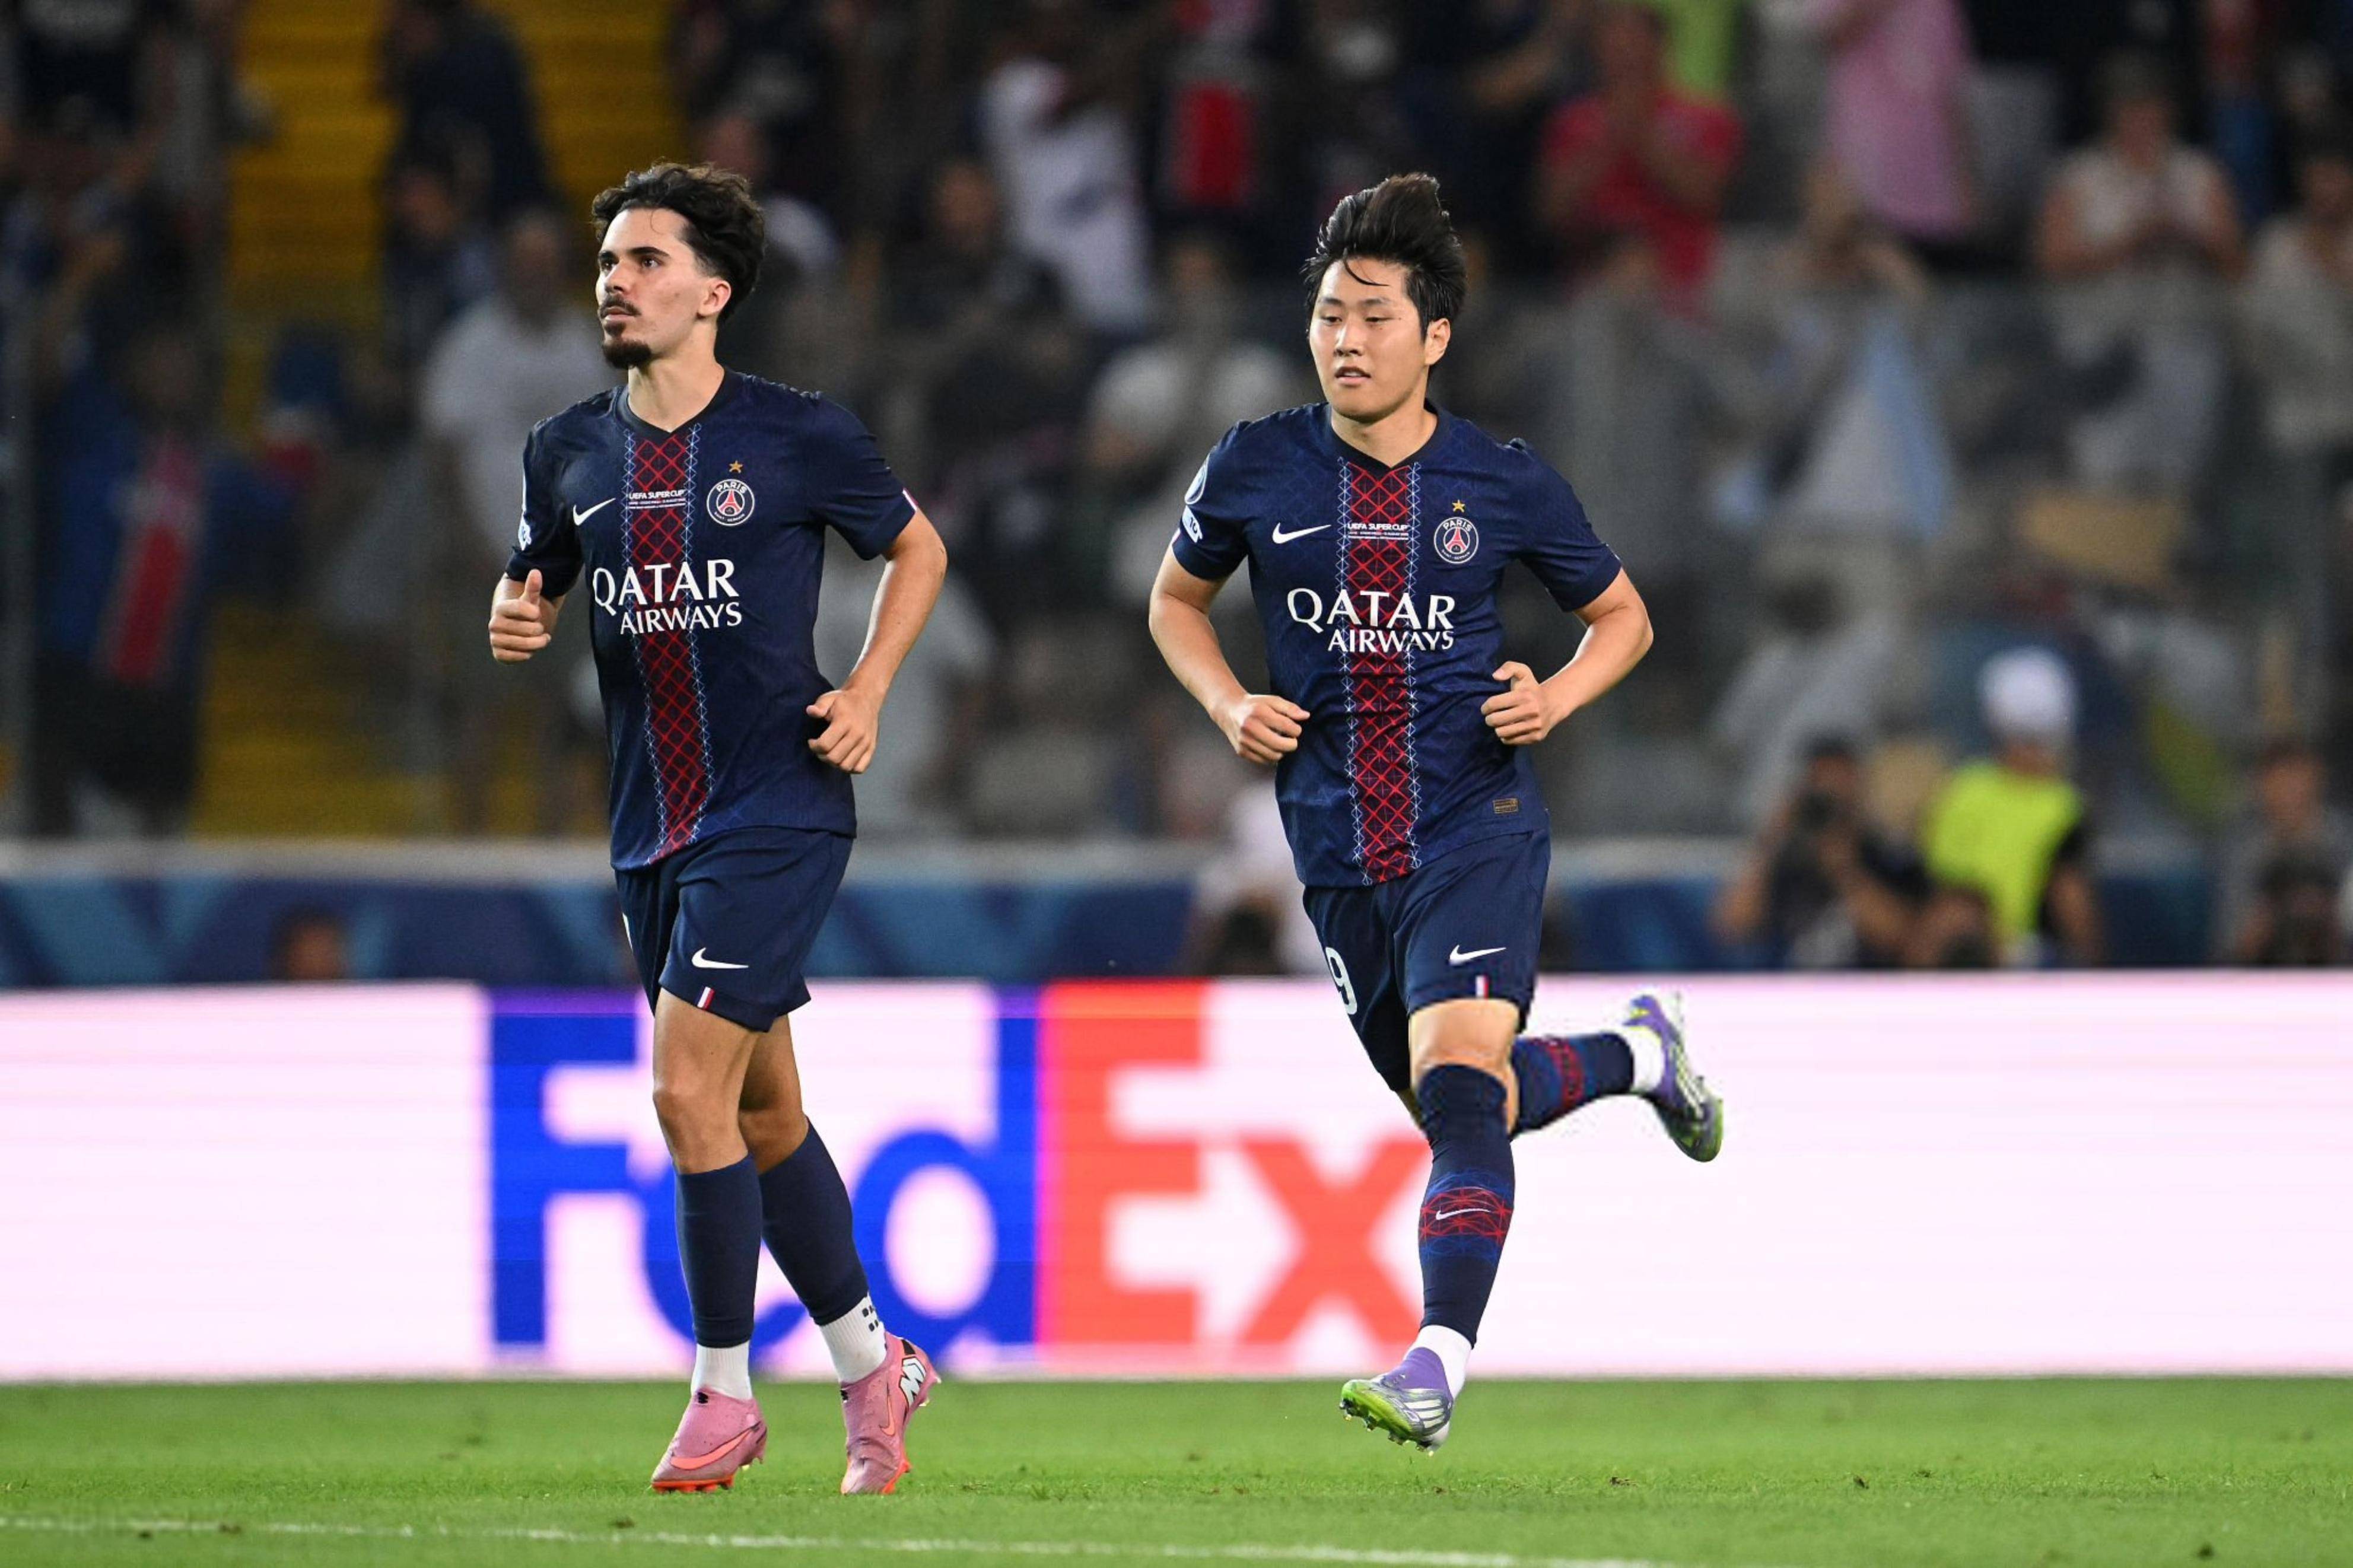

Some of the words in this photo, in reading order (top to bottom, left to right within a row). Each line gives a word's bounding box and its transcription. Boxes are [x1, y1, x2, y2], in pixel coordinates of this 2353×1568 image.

[647, 491, 670, 499] SUPER
[670, 489, 685, 497] CUP
[716, 481, 748, 494] PARIS
[1442, 519, 1473, 532] PARIS
[592, 559, 740, 616] QATAR
[620, 602, 743, 635] AIRWAYS
[1287, 587, 1455, 634] QATAR
[1327, 629, 1455, 653] AIRWAYS
